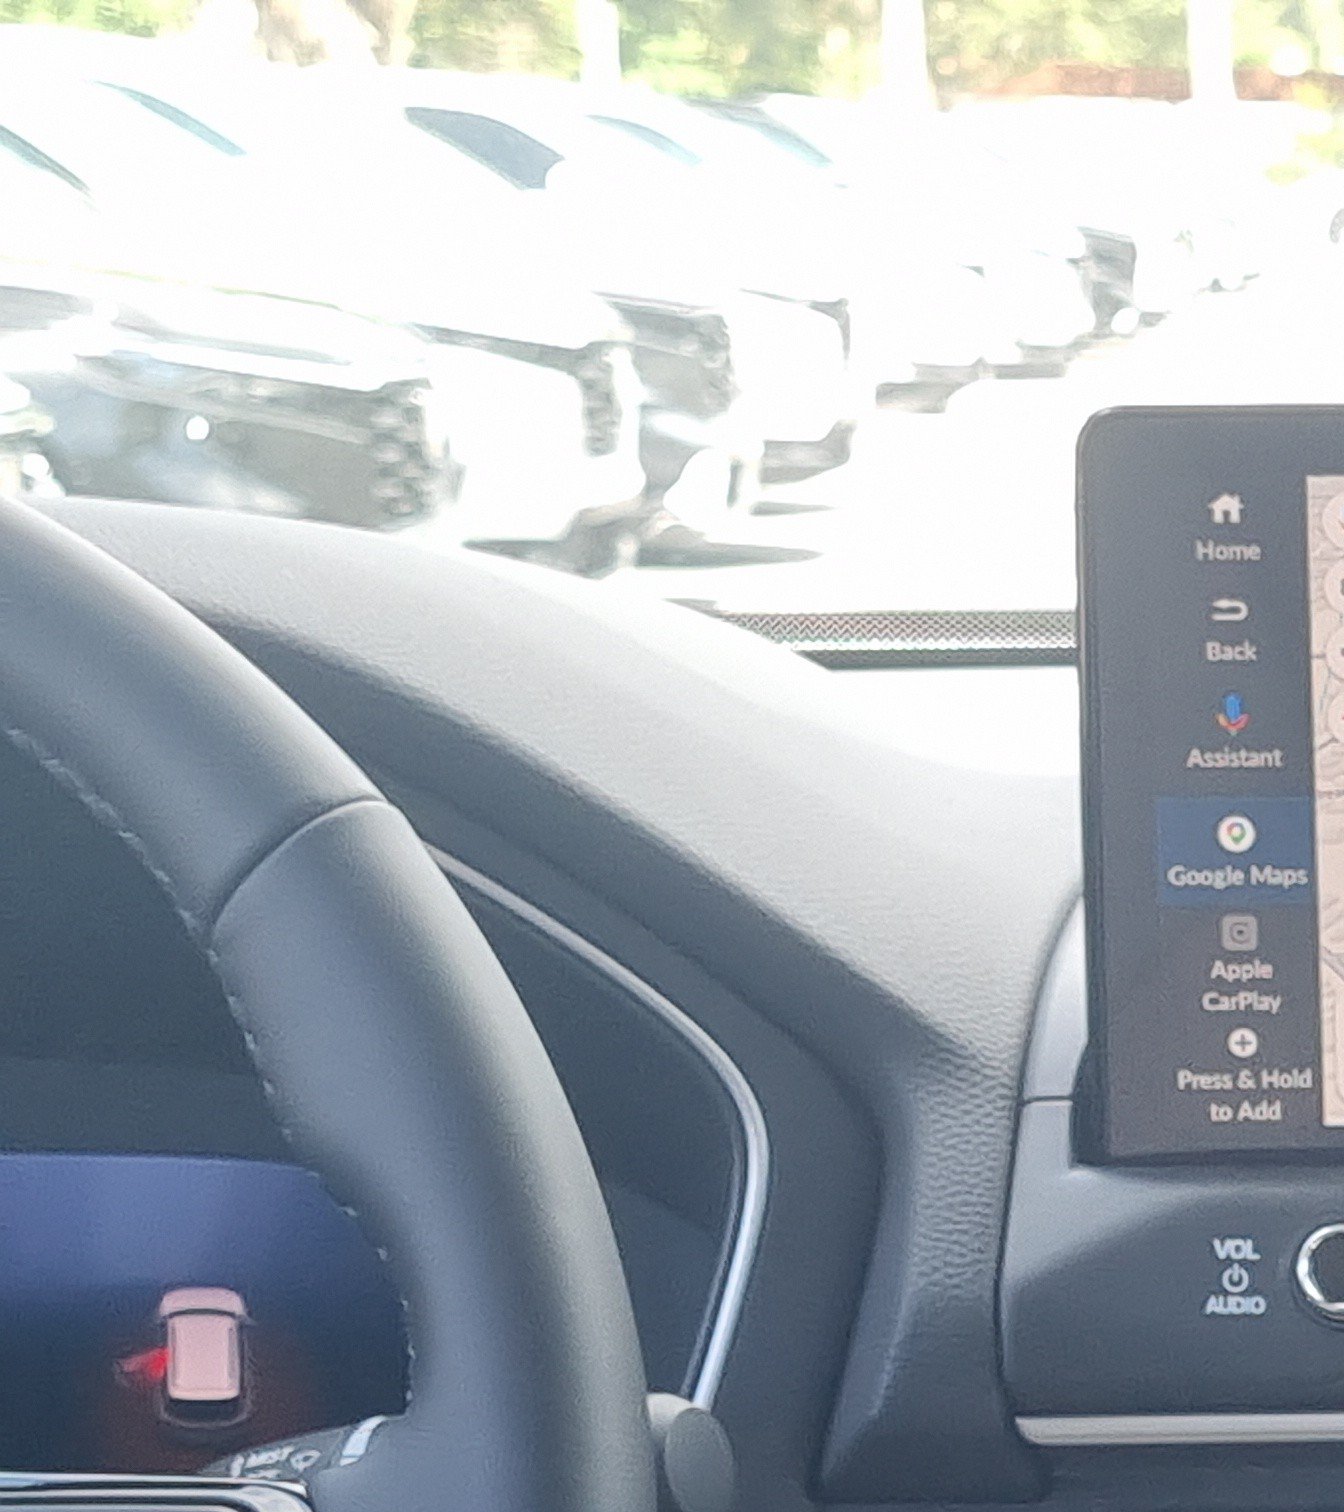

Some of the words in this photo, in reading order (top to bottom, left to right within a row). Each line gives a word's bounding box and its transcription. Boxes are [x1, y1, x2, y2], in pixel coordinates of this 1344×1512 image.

[1196, 541, 1261, 561] Home
[1206, 641, 1257, 662] Back
[1187, 746, 1283, 769] Assistant
[1167, 864, 1245, 890] Google
[1250, 865, 1309, 889] Maps
[1210, 960, 1273, 982] Apple
[1202, 992, 1281, 1014] CarPlay
[1177, 1069, 1233, 1090] Press
[1238, 1069, 1256, 1089] &
[1261, 1067, 1312, 1089] Hold
[1210, 1103, 1233, 1122] to
[1237, 1101, 1281, 1121] Add
[1213, 1238, 1261, 1260] VOL
[1205, 1295, 1266, 1315] AUDIO
